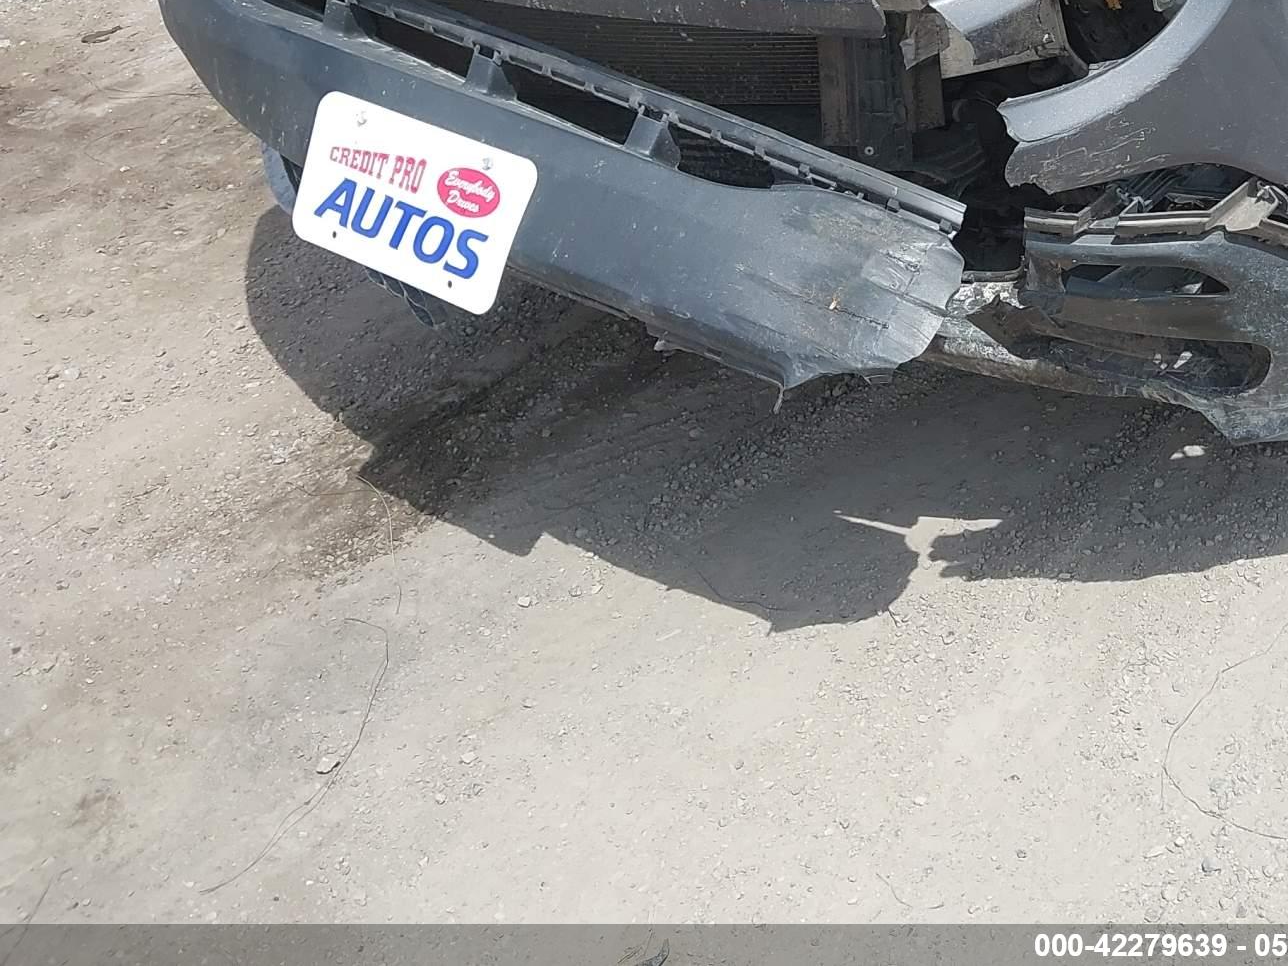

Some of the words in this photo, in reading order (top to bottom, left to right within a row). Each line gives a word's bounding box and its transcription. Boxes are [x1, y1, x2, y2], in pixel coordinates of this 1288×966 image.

[329, 145, 390, 180] CREDIT
[388, 154, 428, 195] PRO
[444, 170, 496, 203] Everybody
[446, 189, 480, 213] Drives
[314, 177, 489, 280] AUTOS
